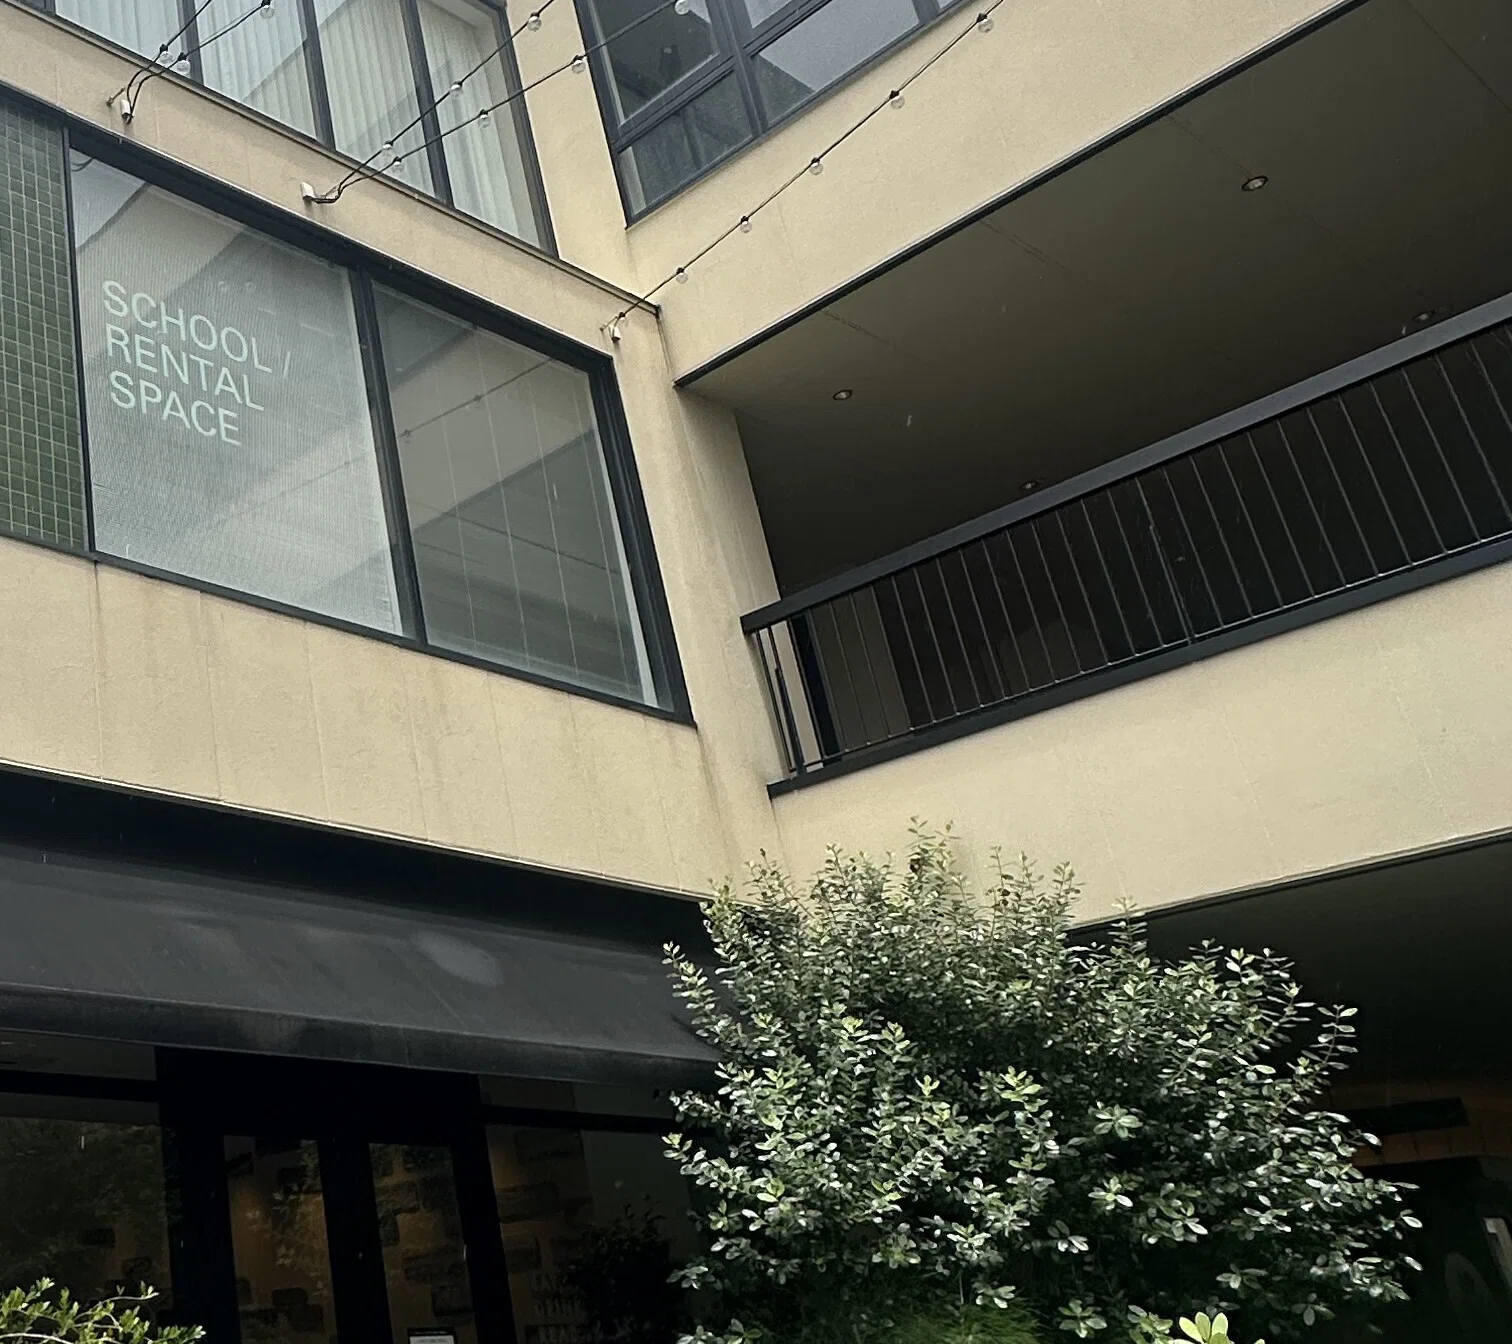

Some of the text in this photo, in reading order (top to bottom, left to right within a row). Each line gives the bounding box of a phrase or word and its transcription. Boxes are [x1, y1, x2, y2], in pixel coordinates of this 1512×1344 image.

[102, 279, 273, 374] SCHOOL
[106, 323, 265, 412] RENTAL
[110, 370, 241, 445] SPACE
